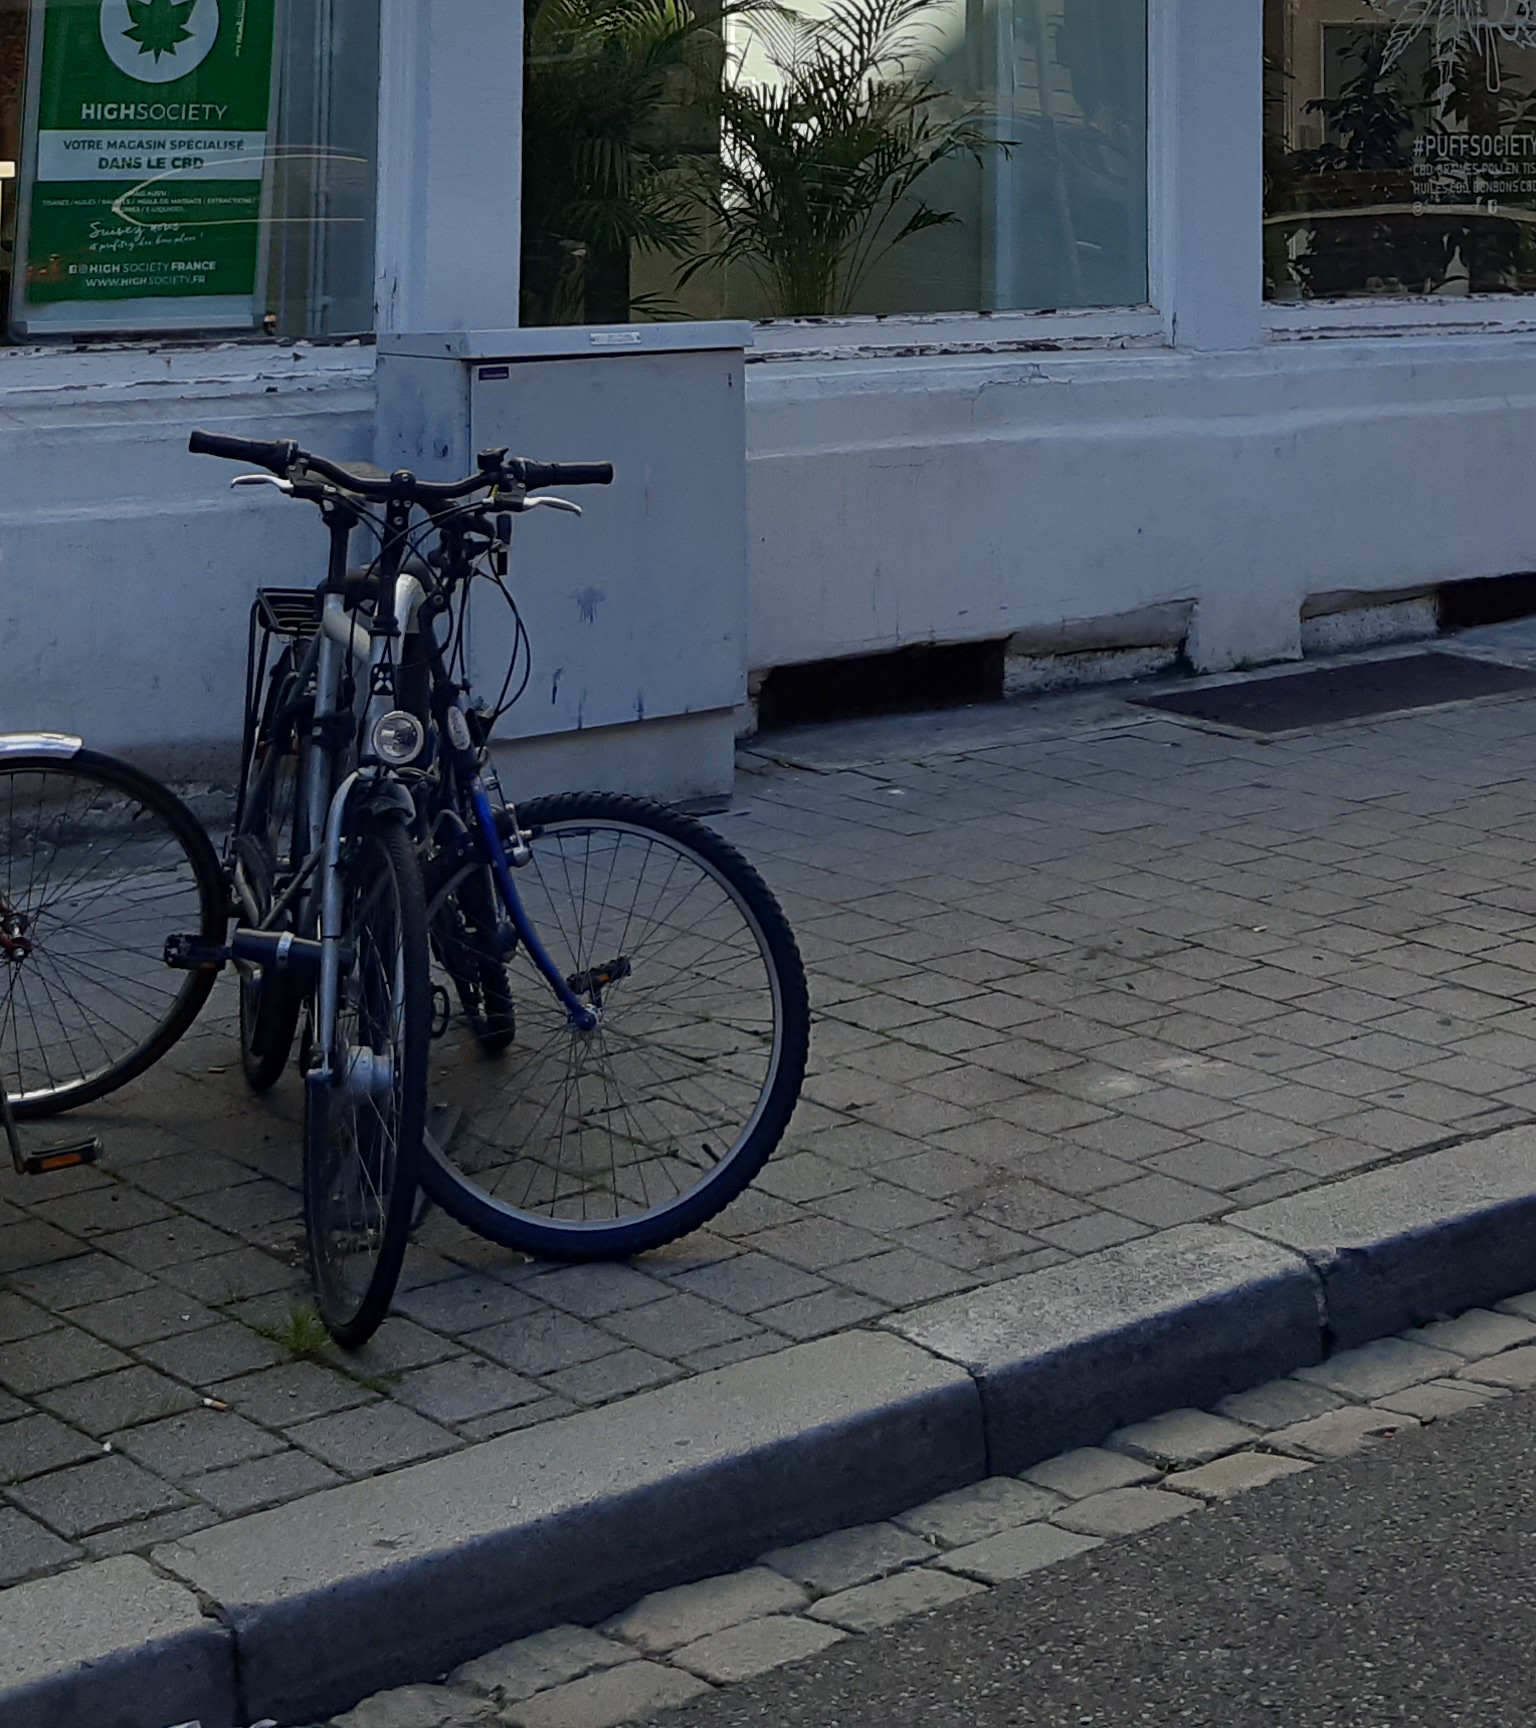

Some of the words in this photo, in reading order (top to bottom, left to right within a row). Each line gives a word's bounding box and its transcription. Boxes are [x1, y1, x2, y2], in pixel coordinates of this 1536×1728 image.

[81, 103, 228, 121] HIGHSOCIETY
[63, 139, 103, 150] VOTRE
[106, 139, 166, 150] MAGASIN
[169, 138, 245, 151] SPÉCIALISÉ
[98, 157, 142, 169] DANS
[147, 157, 166, 169] LE
[171, 158, 205, 169] CBD
[89, 264, 120, 273] HIGH
[122, 262, 170, 273] SOCIETY
[171, 260, 216, 271] FRANCE
